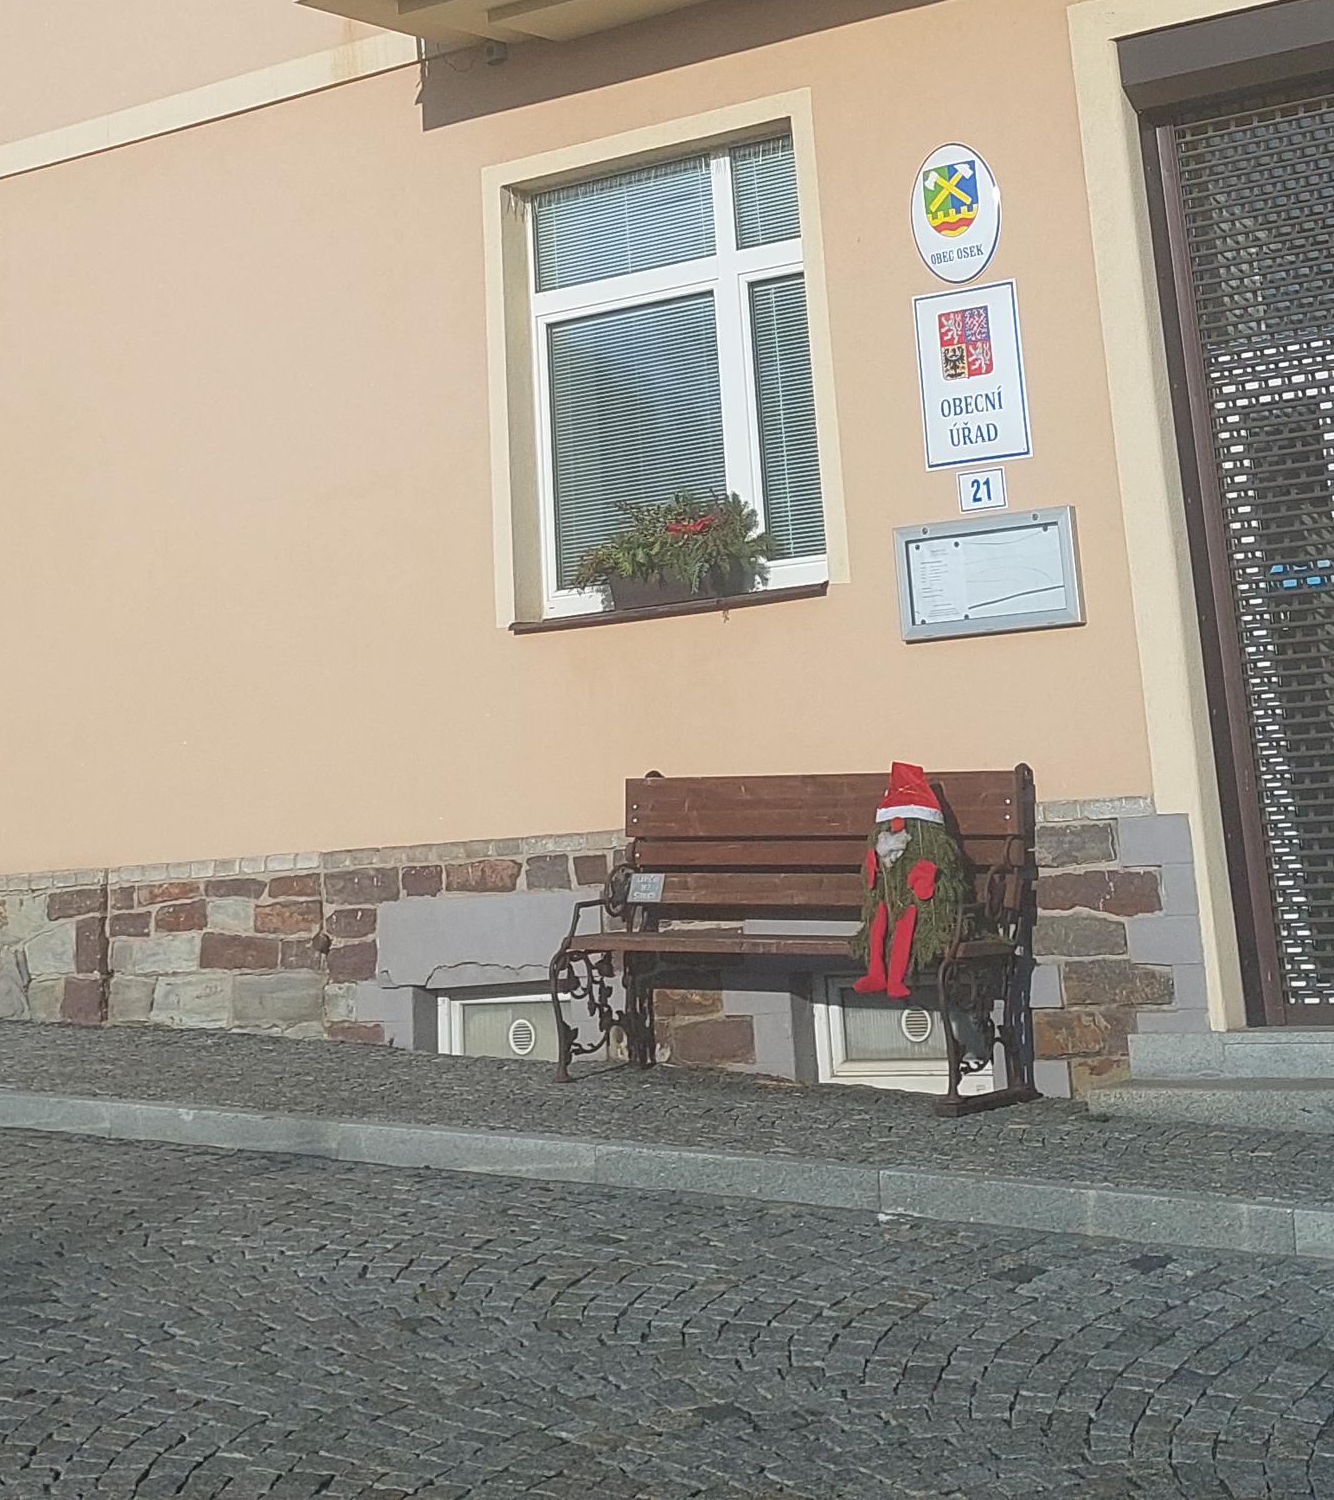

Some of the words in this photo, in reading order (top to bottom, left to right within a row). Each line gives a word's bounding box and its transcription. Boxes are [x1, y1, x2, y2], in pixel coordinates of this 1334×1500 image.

[930, 250, 955, 266] OBEC
[956, 244, 985, 260] OSEK
[940, 385, 1004, 418] OBECNÍ
[949, 421, 999, 447] ÚŘAD
[970, 477, 992, 503] 21
